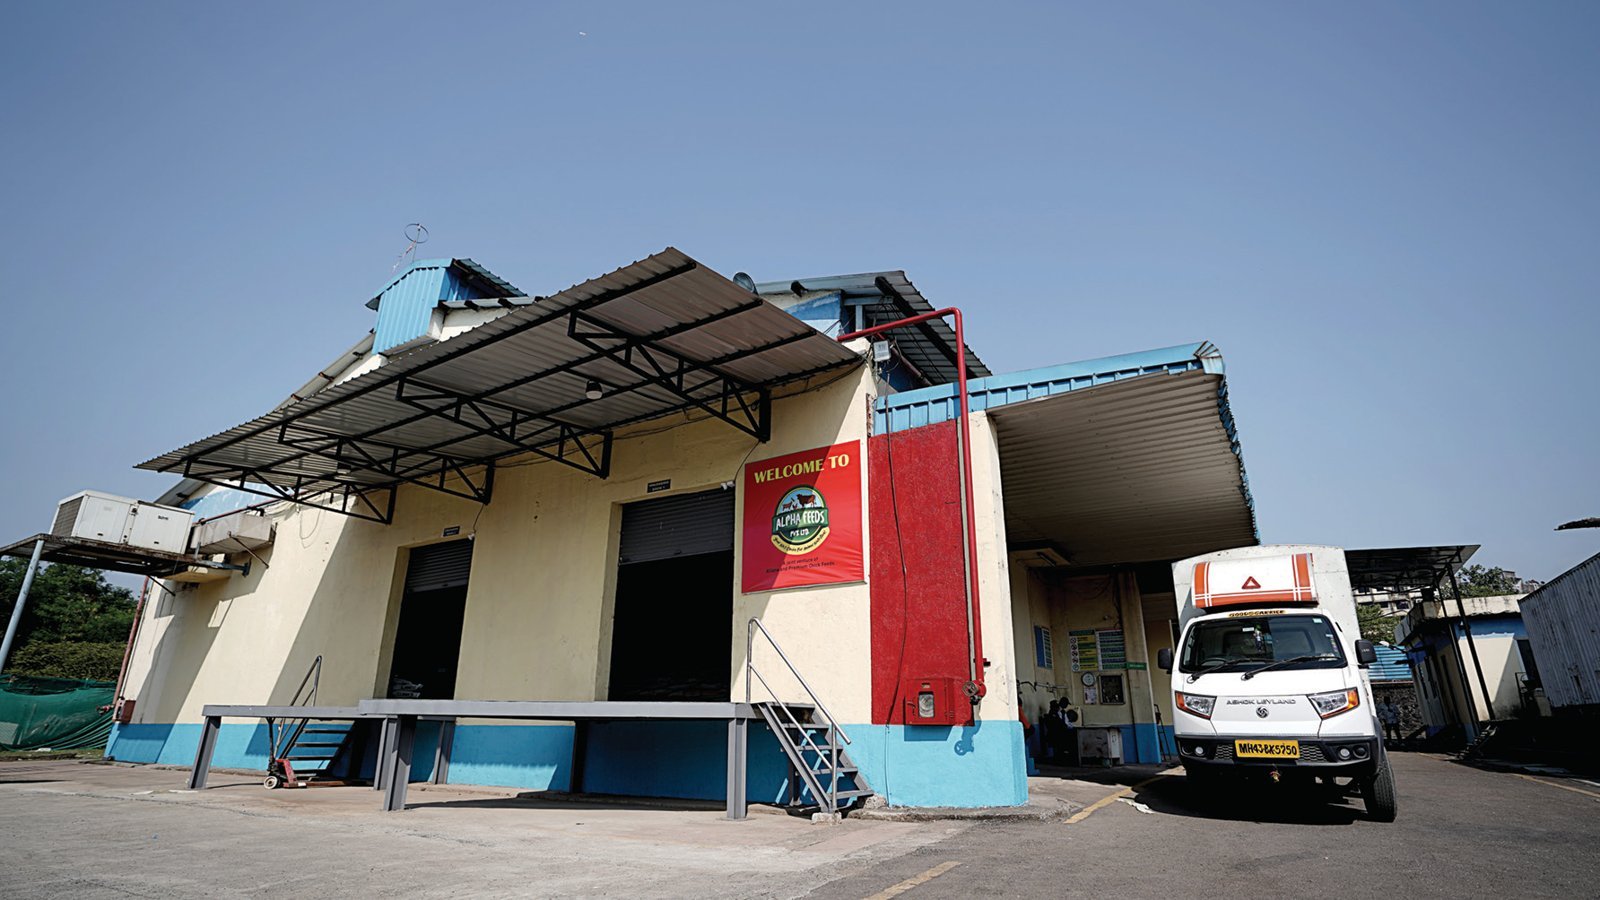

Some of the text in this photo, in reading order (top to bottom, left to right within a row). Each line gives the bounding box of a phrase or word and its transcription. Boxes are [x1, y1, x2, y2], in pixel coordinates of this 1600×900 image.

[754, 453, 850, 484] WELCOME TO
[775, 509, 825, 531] ALPHA FEEDS
